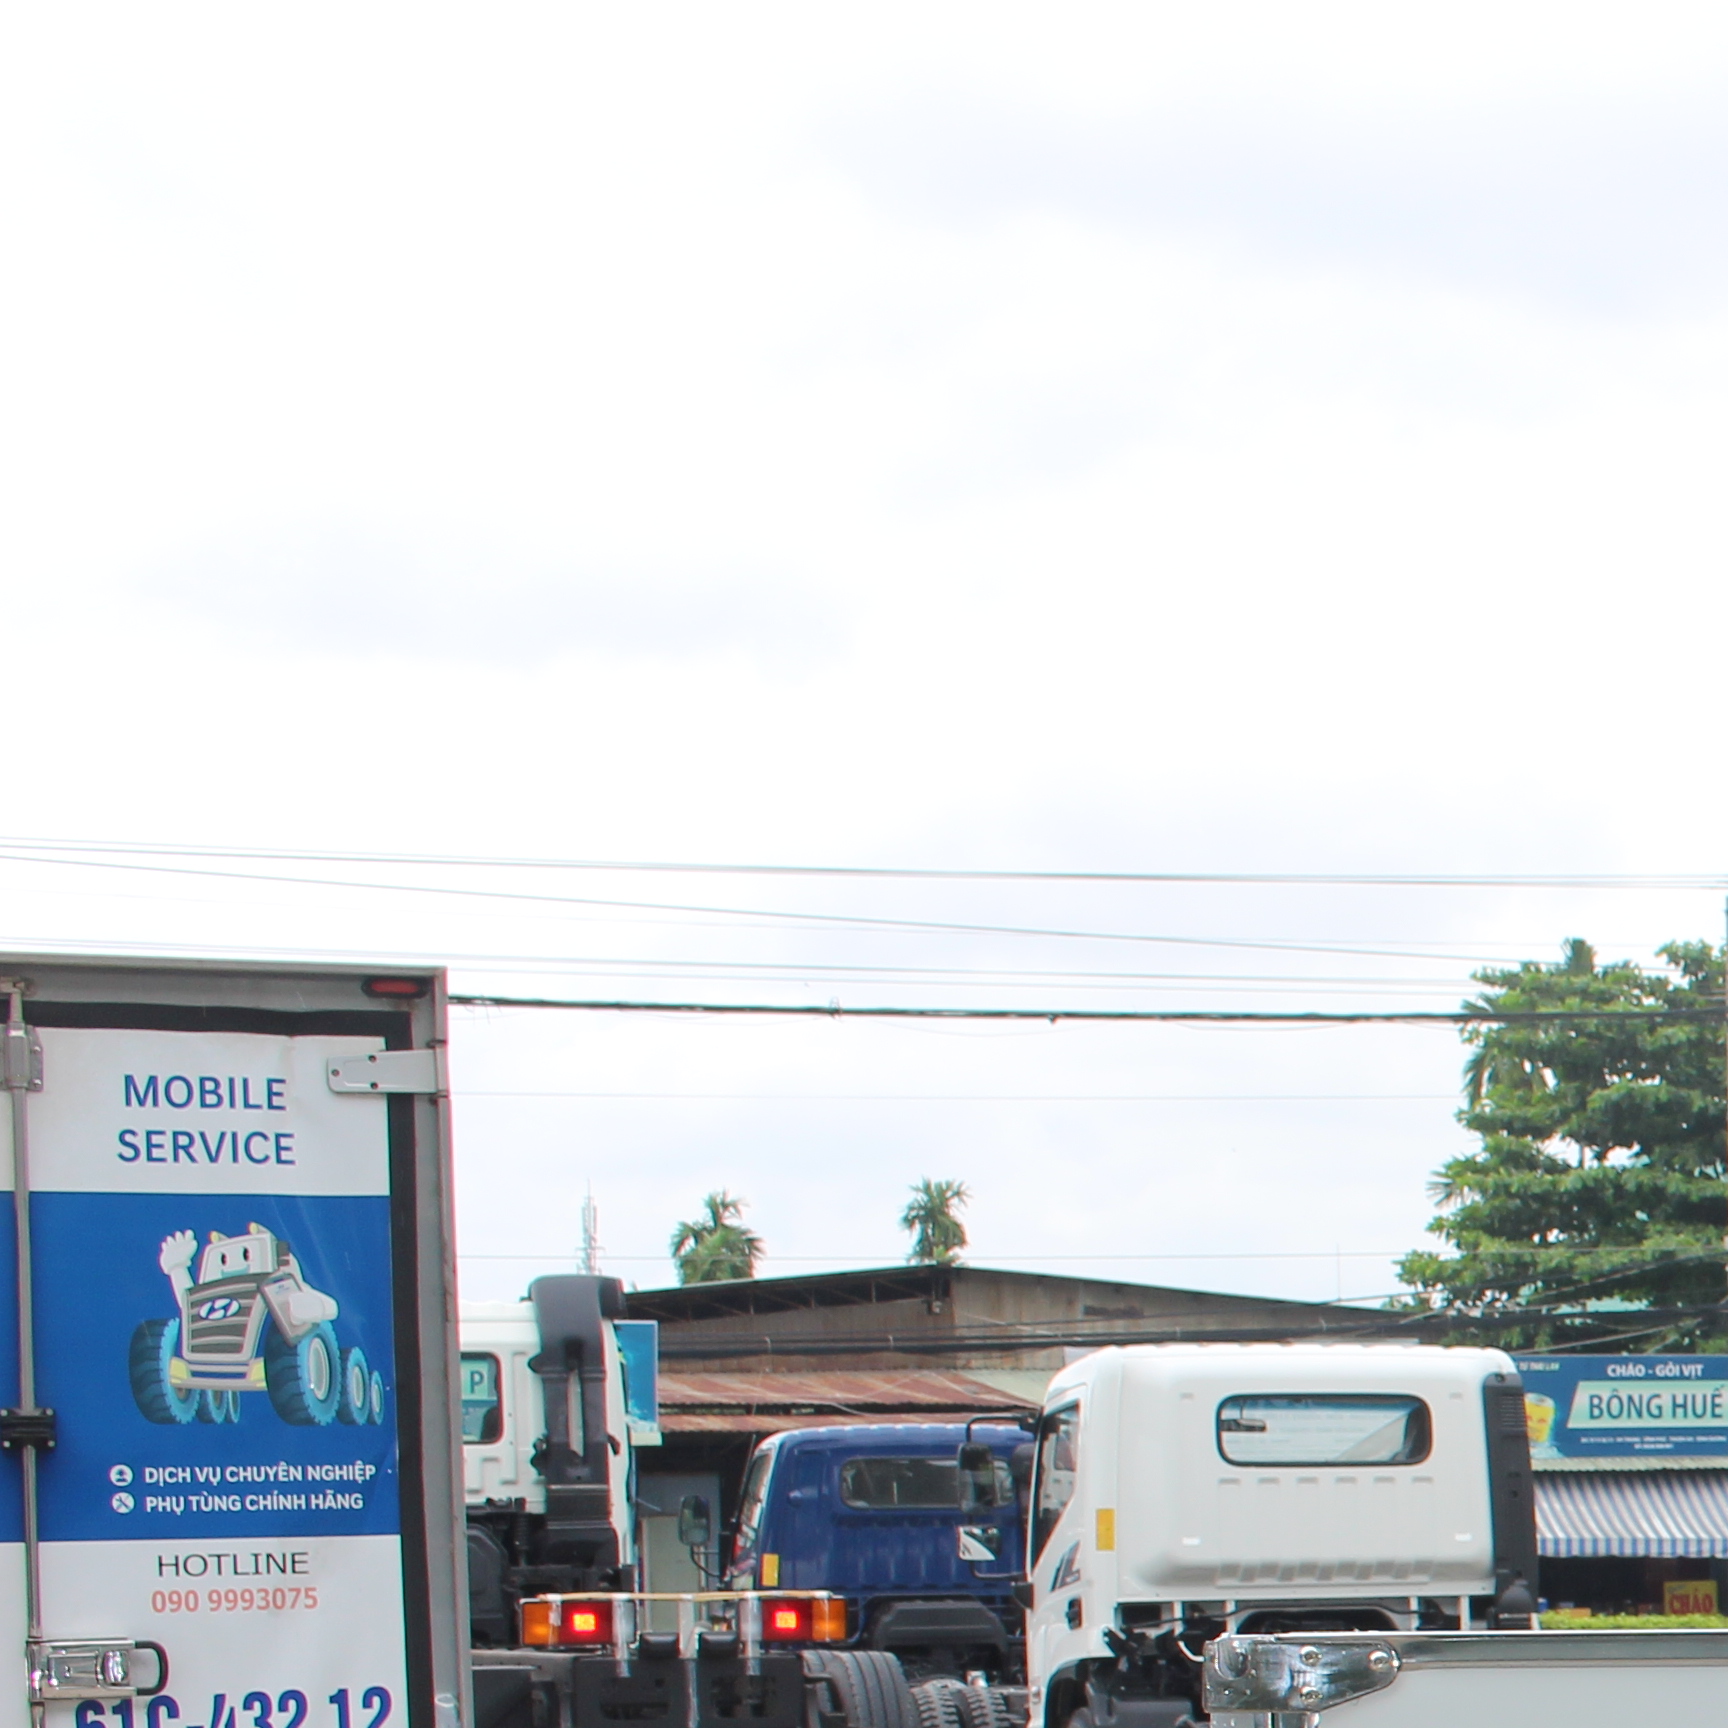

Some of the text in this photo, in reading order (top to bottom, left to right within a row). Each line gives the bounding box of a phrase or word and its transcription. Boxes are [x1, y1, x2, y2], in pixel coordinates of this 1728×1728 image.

[123, 1074, 288, 1111] MOBILE
[116, 1129, 298, 1166] SERVICE
[1607, 1361, 1646, 1378] CHÁO
[1681, 1363, 1704, 1380] VỊT
[1589, 1384, 1725, 1419] BÔNG HUẾ
[145, 1460, 376, 1487] DỊCH VỤ CHUYÊN NGHIỆP
[146, 1489, 364, 1516] PHỤ TÙNG CHÍNH HÃNG
[157, 1551, 309, 1578] HOTLINE
[151, 1586, 318, 1613] 090 9993075
